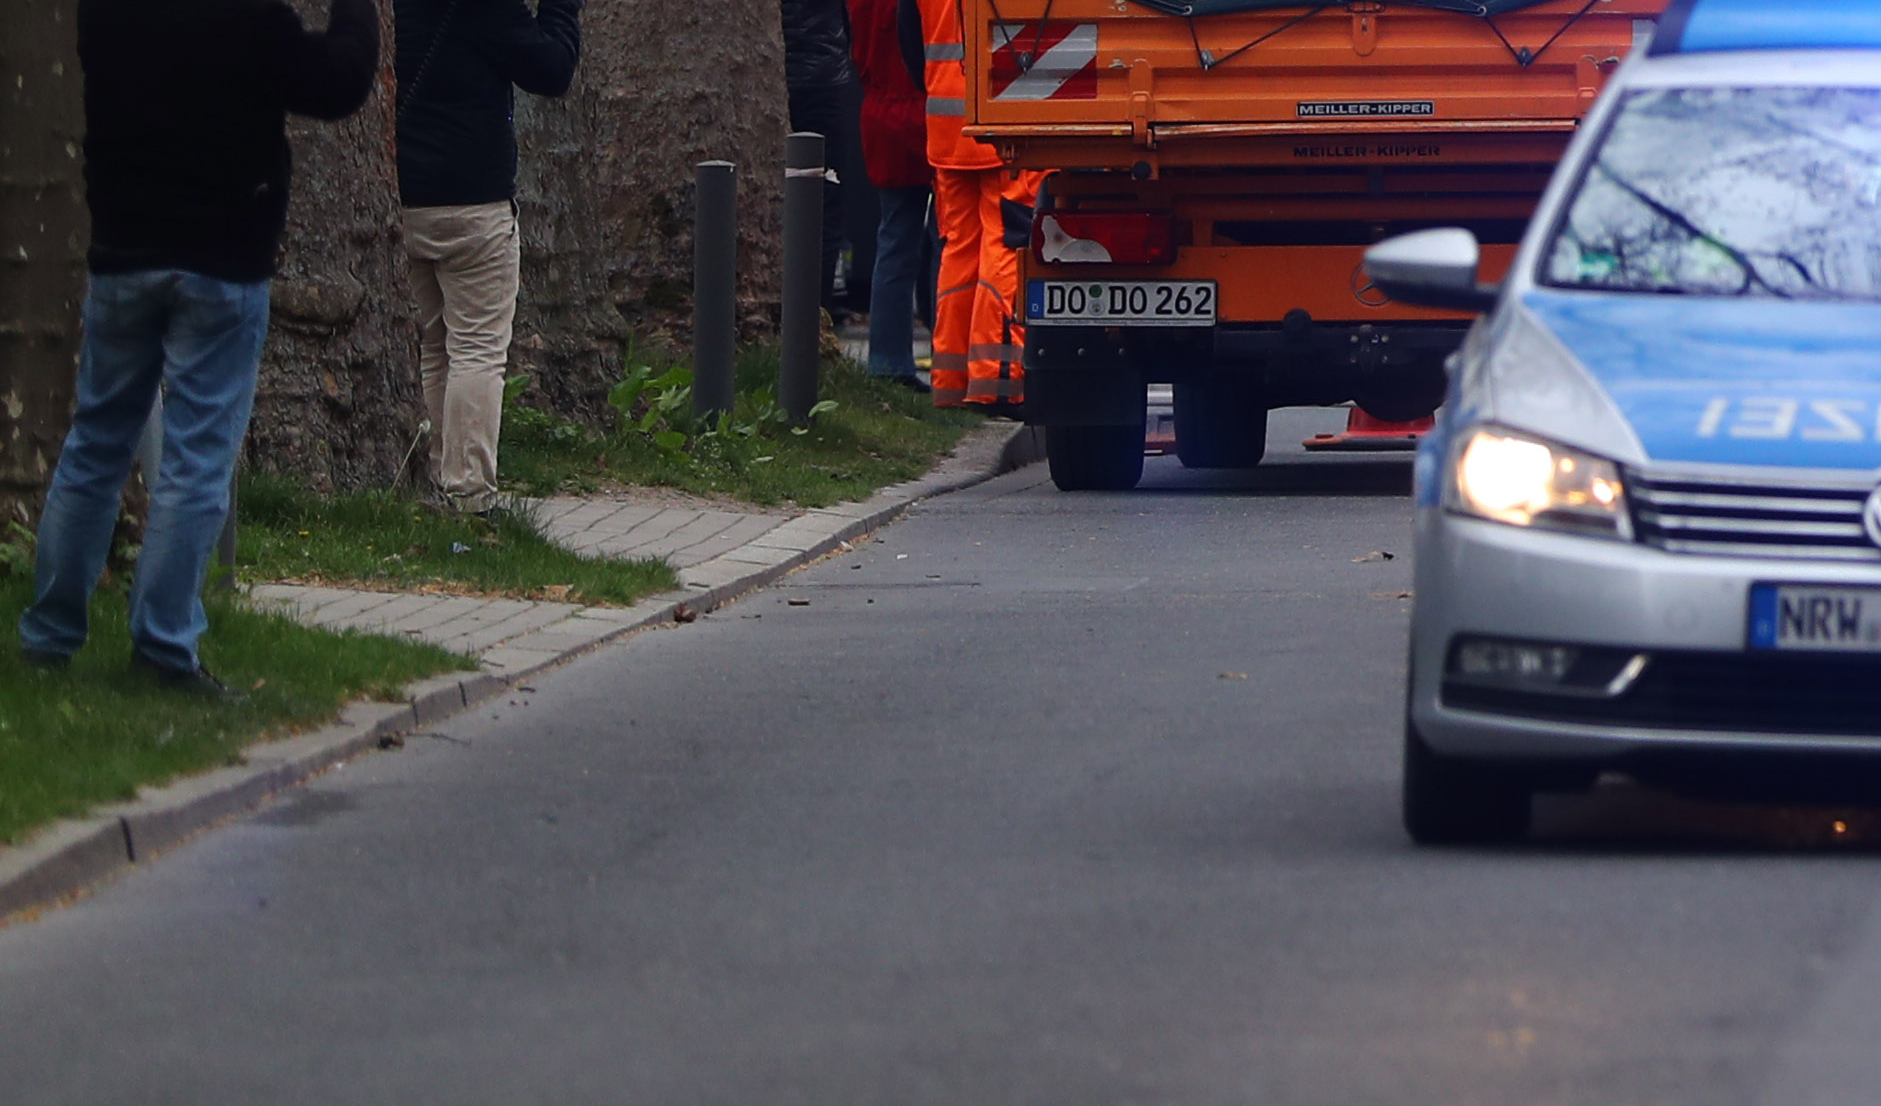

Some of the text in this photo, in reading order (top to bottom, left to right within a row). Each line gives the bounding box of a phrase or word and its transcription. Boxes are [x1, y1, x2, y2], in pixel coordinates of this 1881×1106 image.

[1299, 102, 1432, 116] MEILLER-KIPPER
[1046, 284, 1213, 316] DO DO 262
[1778, 596, 1863, 641] NRW
